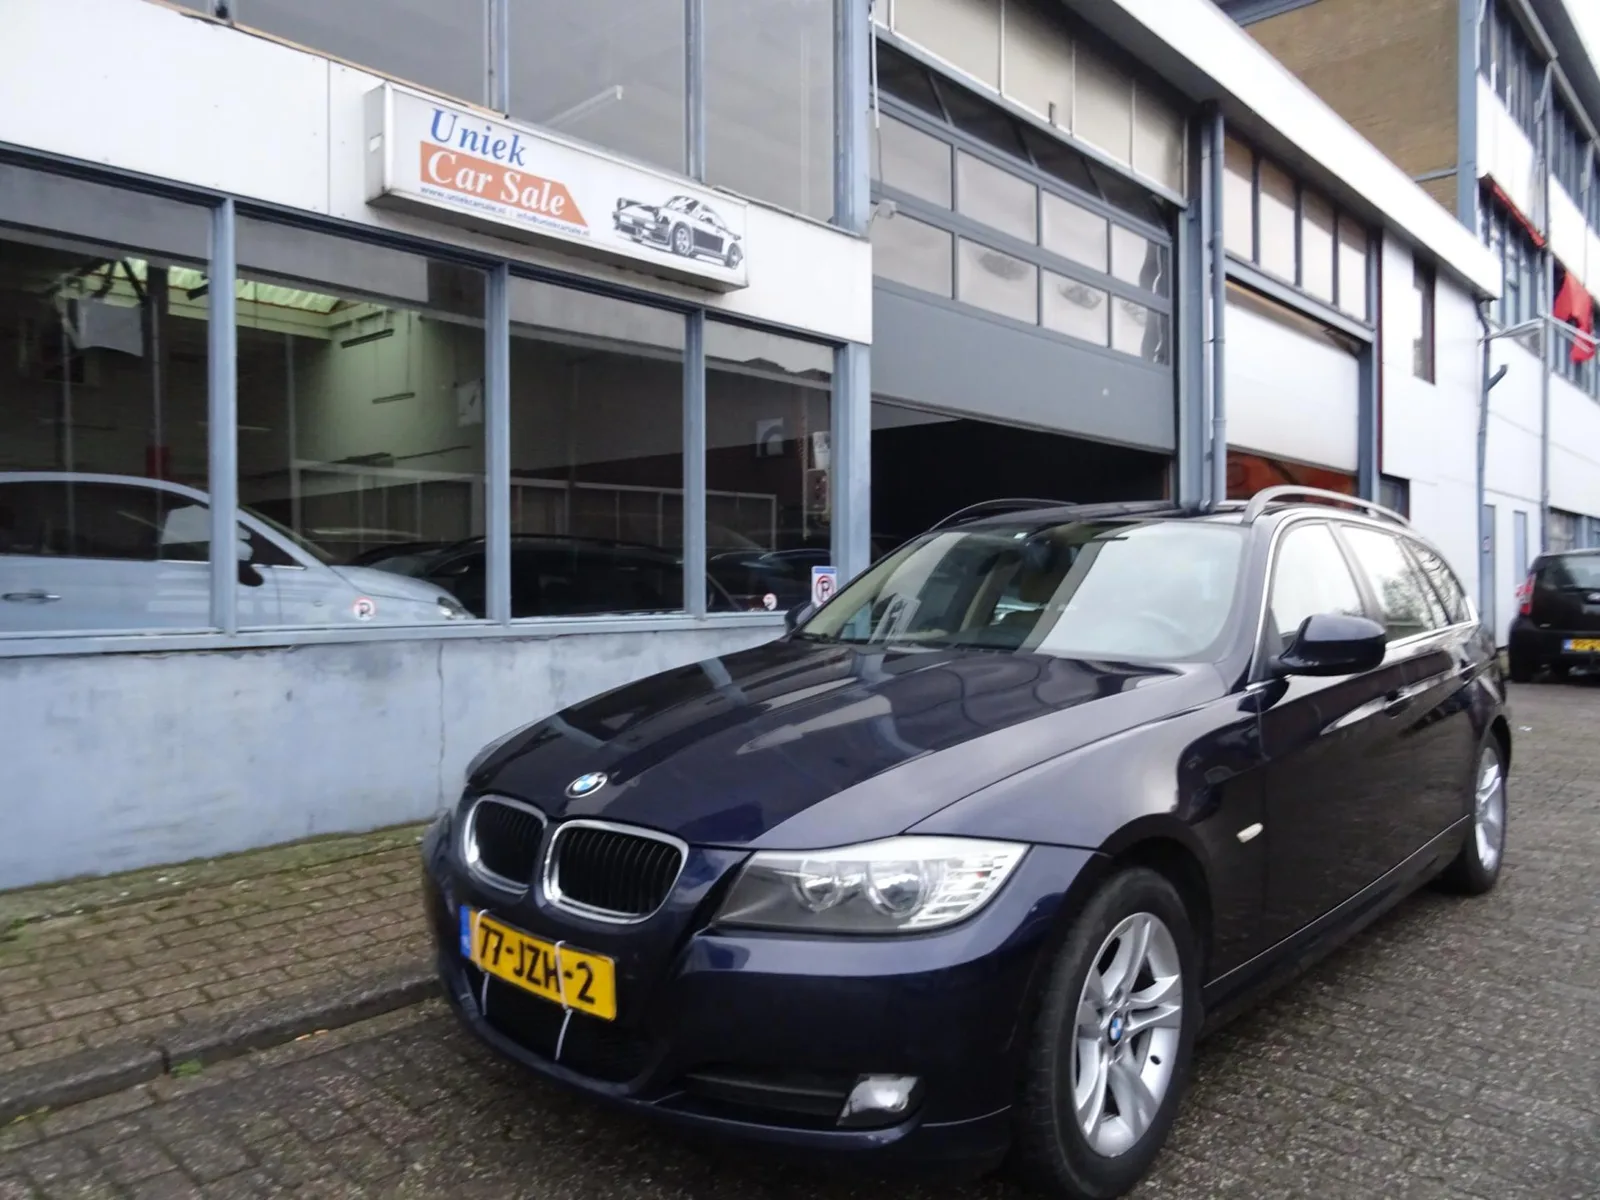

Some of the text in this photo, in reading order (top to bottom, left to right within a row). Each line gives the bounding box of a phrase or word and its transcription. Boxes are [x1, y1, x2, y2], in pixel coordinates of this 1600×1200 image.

[431, 108, 527, 167] Uniek
[428, 151, 565, 216] Car Sale
[479, 921, 596, 1005] 77-JZH-2
